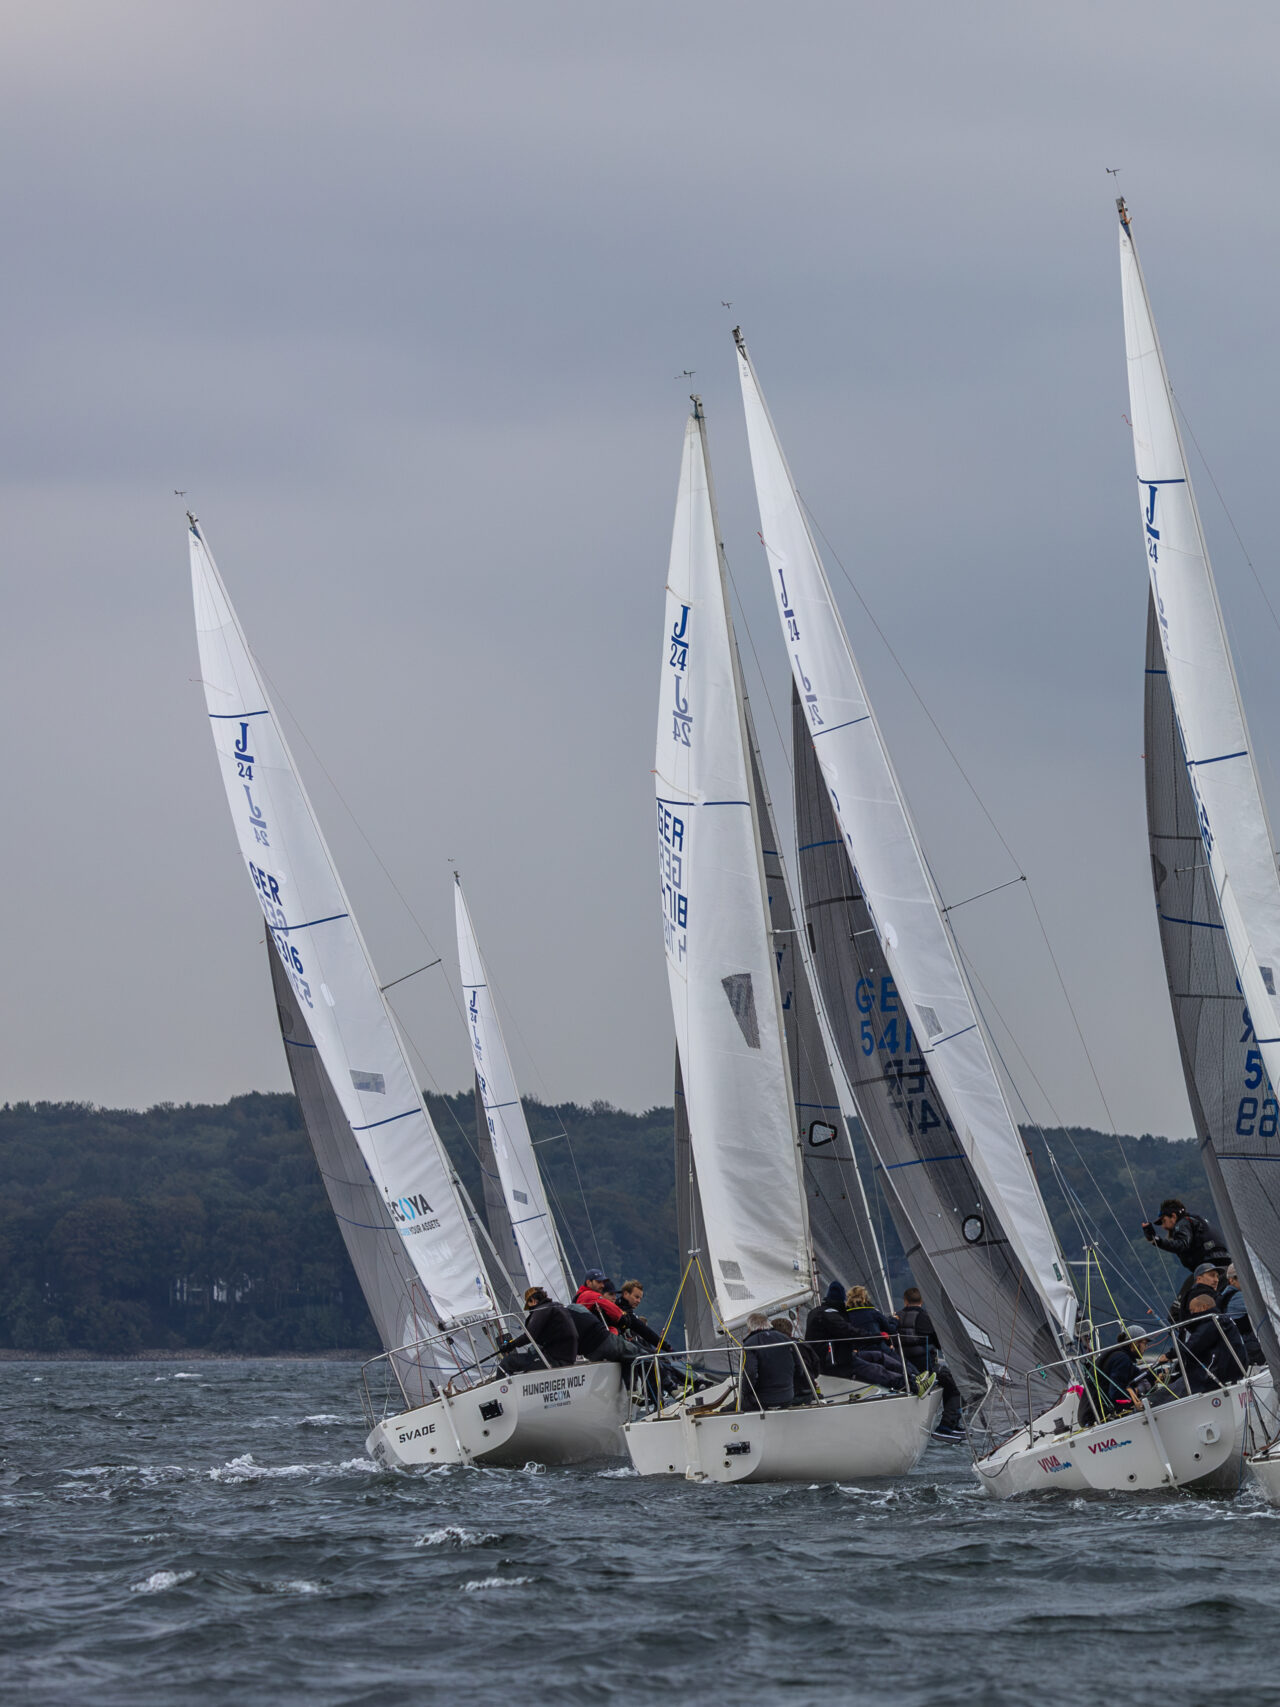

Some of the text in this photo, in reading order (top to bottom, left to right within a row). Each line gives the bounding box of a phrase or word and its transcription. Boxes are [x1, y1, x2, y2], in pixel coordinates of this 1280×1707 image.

[787, 618, 801, 642] 24
[669, 643, 688, 671] 24
[237, 762, 254, 781] 24
[658, 801, 685, 852] GER
[249, 861, 283, 906] GER
[855, 975, 899, 1014] GE
[860, 1018, 914, 1057] 541
[522, 1374, 586, 1397] HUNGRIGER WOLF
[1088, 1438, 1118, 1454] VIVA
[1038, 1455, 1061, 1473] VIVA
